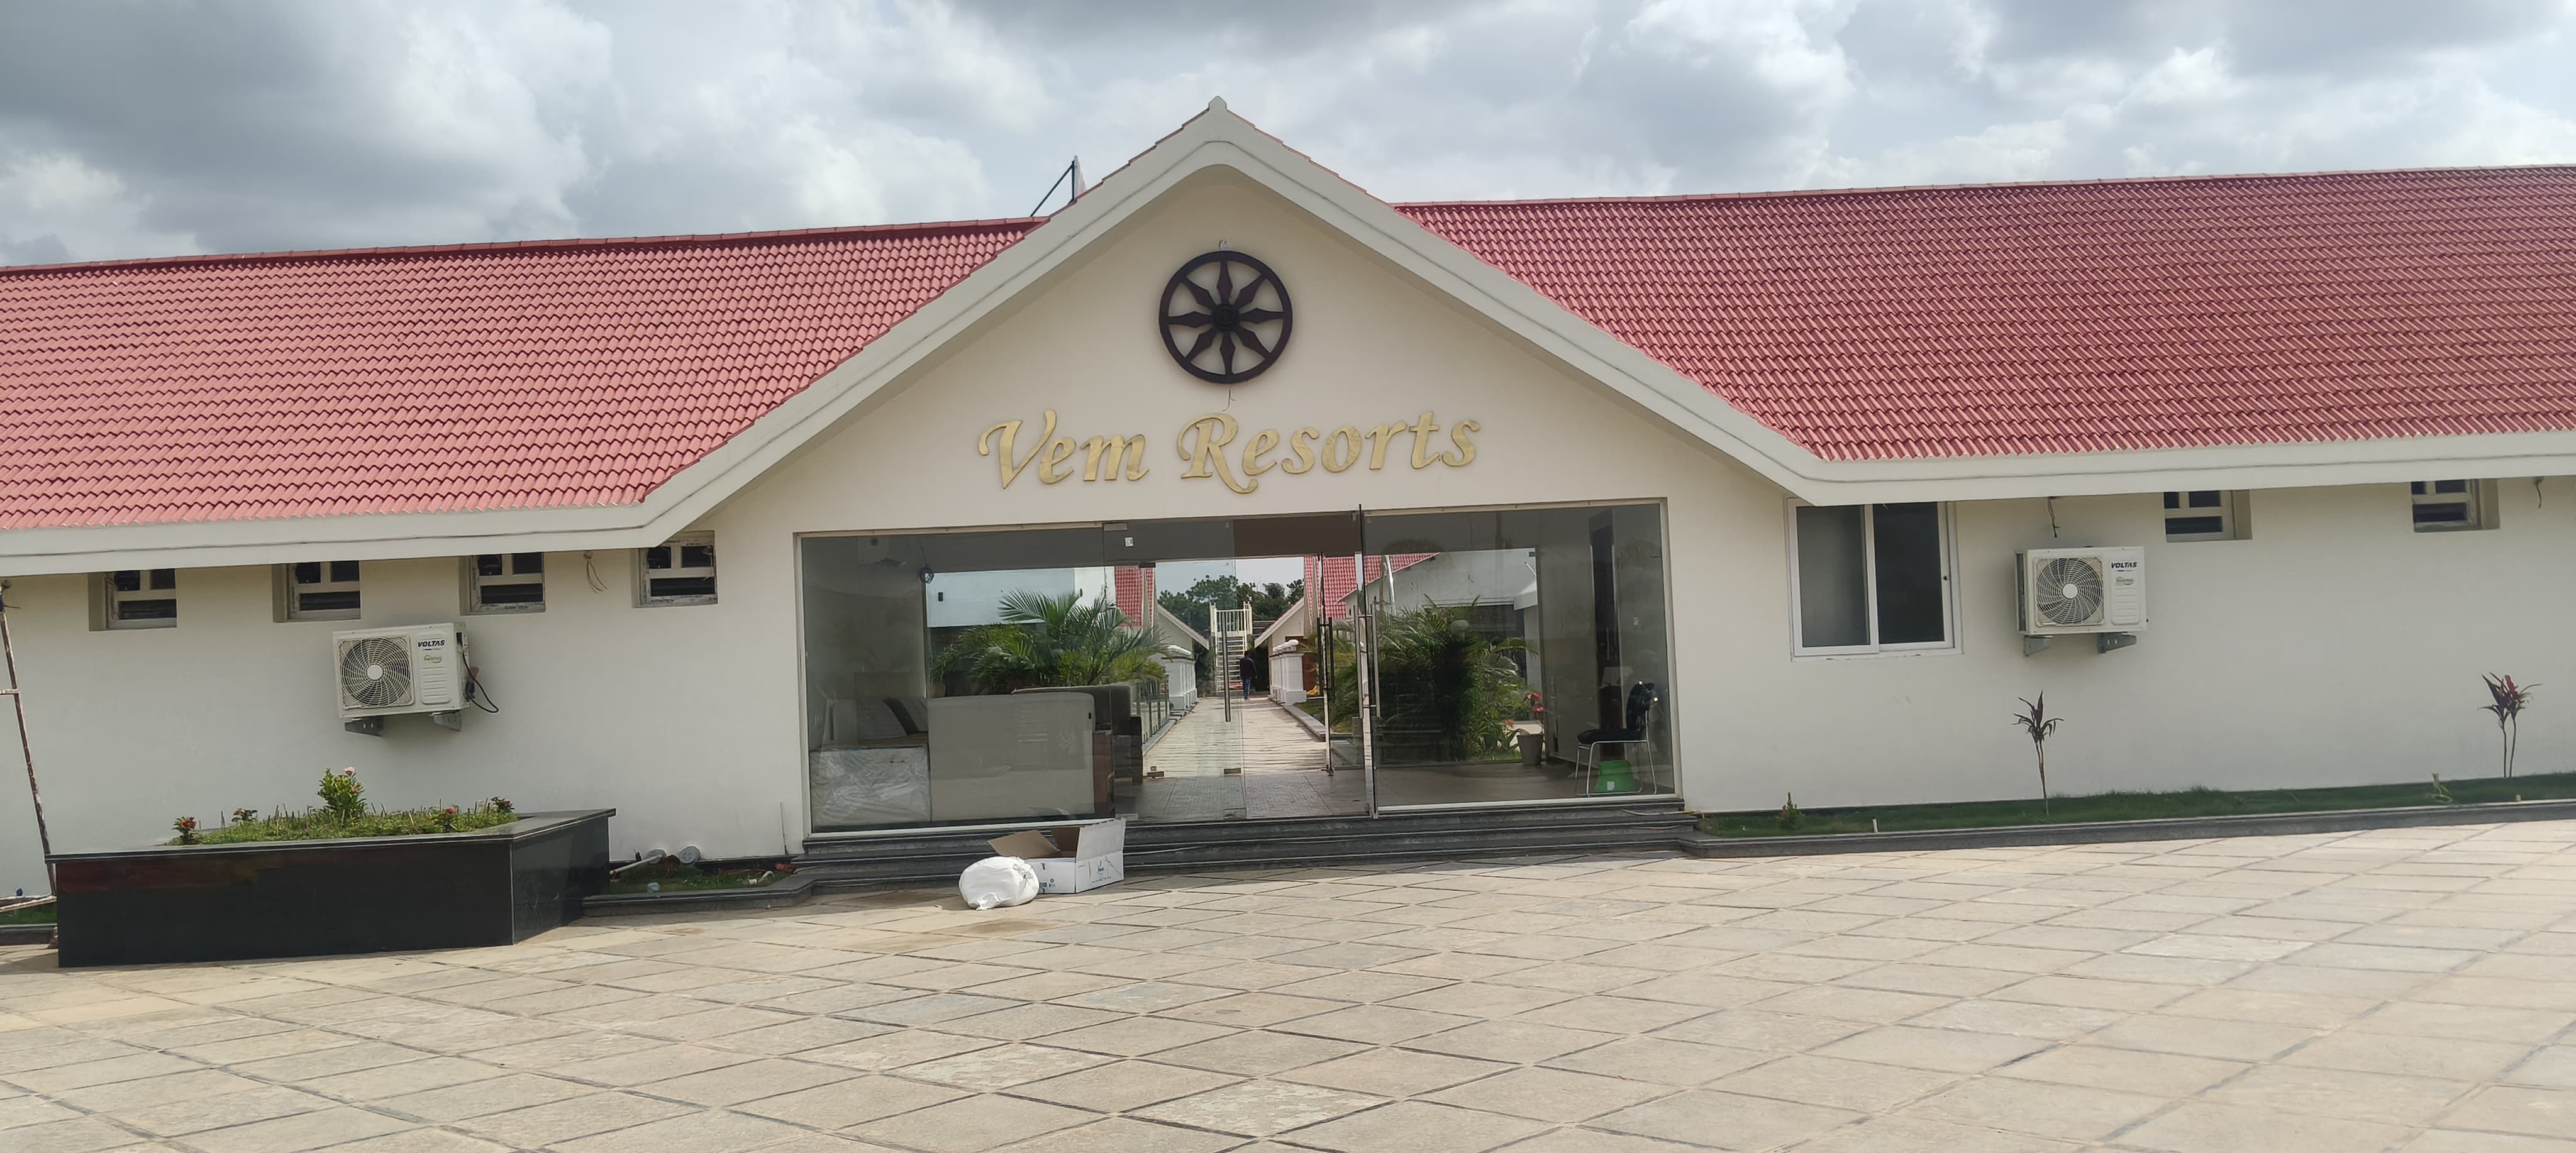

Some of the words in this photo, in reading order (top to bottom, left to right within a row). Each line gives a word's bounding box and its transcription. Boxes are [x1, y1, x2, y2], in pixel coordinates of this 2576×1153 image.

[979, 409, 1149, 489] Vem
[1177, 411, 1482, 494] Resorts
[418, 639, 445, 648] VOLTAS
